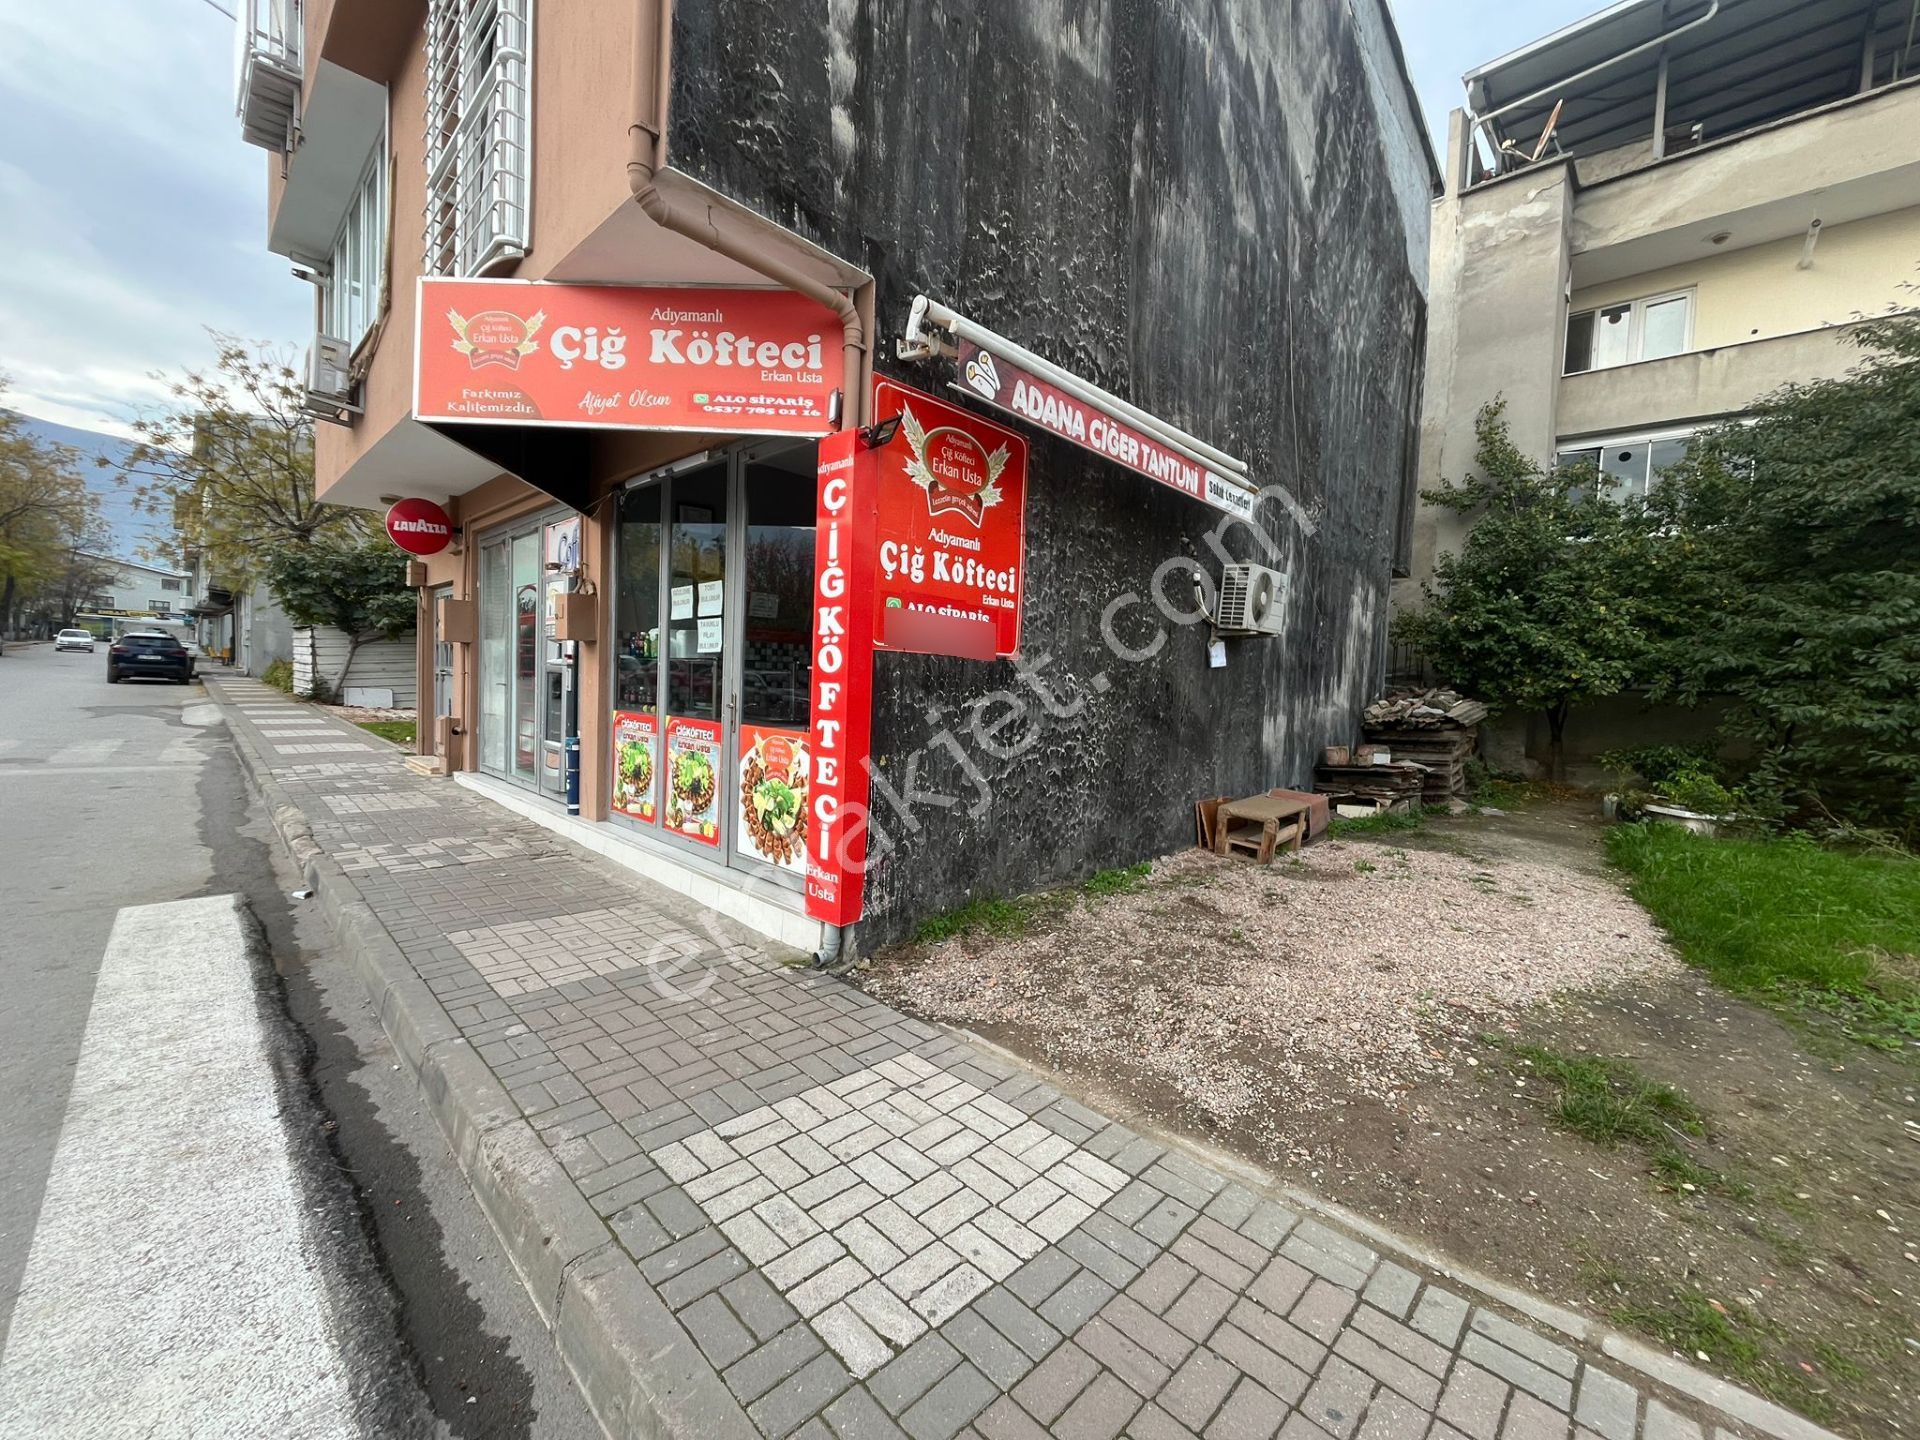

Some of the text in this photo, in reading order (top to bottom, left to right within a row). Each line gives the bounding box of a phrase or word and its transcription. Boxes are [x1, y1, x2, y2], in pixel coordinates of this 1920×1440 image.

[650, 307, 723, 326] Adıyamanlı
[473, 333, 518, 343] Erkan Usta
[550, 325, 823, 370] Çiğ Köfteci
[761, 370, 823, 384] Erkan Usta
[577, 389, 671, 415] Afiyet Olsun
[713, 395, 746, 403] ALO
[1012, 379, 1198, 494] ADANA CİĞER TANTUNİ
[941, 446, 975, 466] Çiğ Köfteci
[933, 457, 982, 486] Erkan Usta
[393, 518, 448, 535] LAVAZZA
[928, 528, 980, 551] Adıyamanlı
[880, 540, 1015, 593] Çiğ Köfteci
[806, 863, 839, 884] Erkan
[808, 882, 835, 903] Usta
